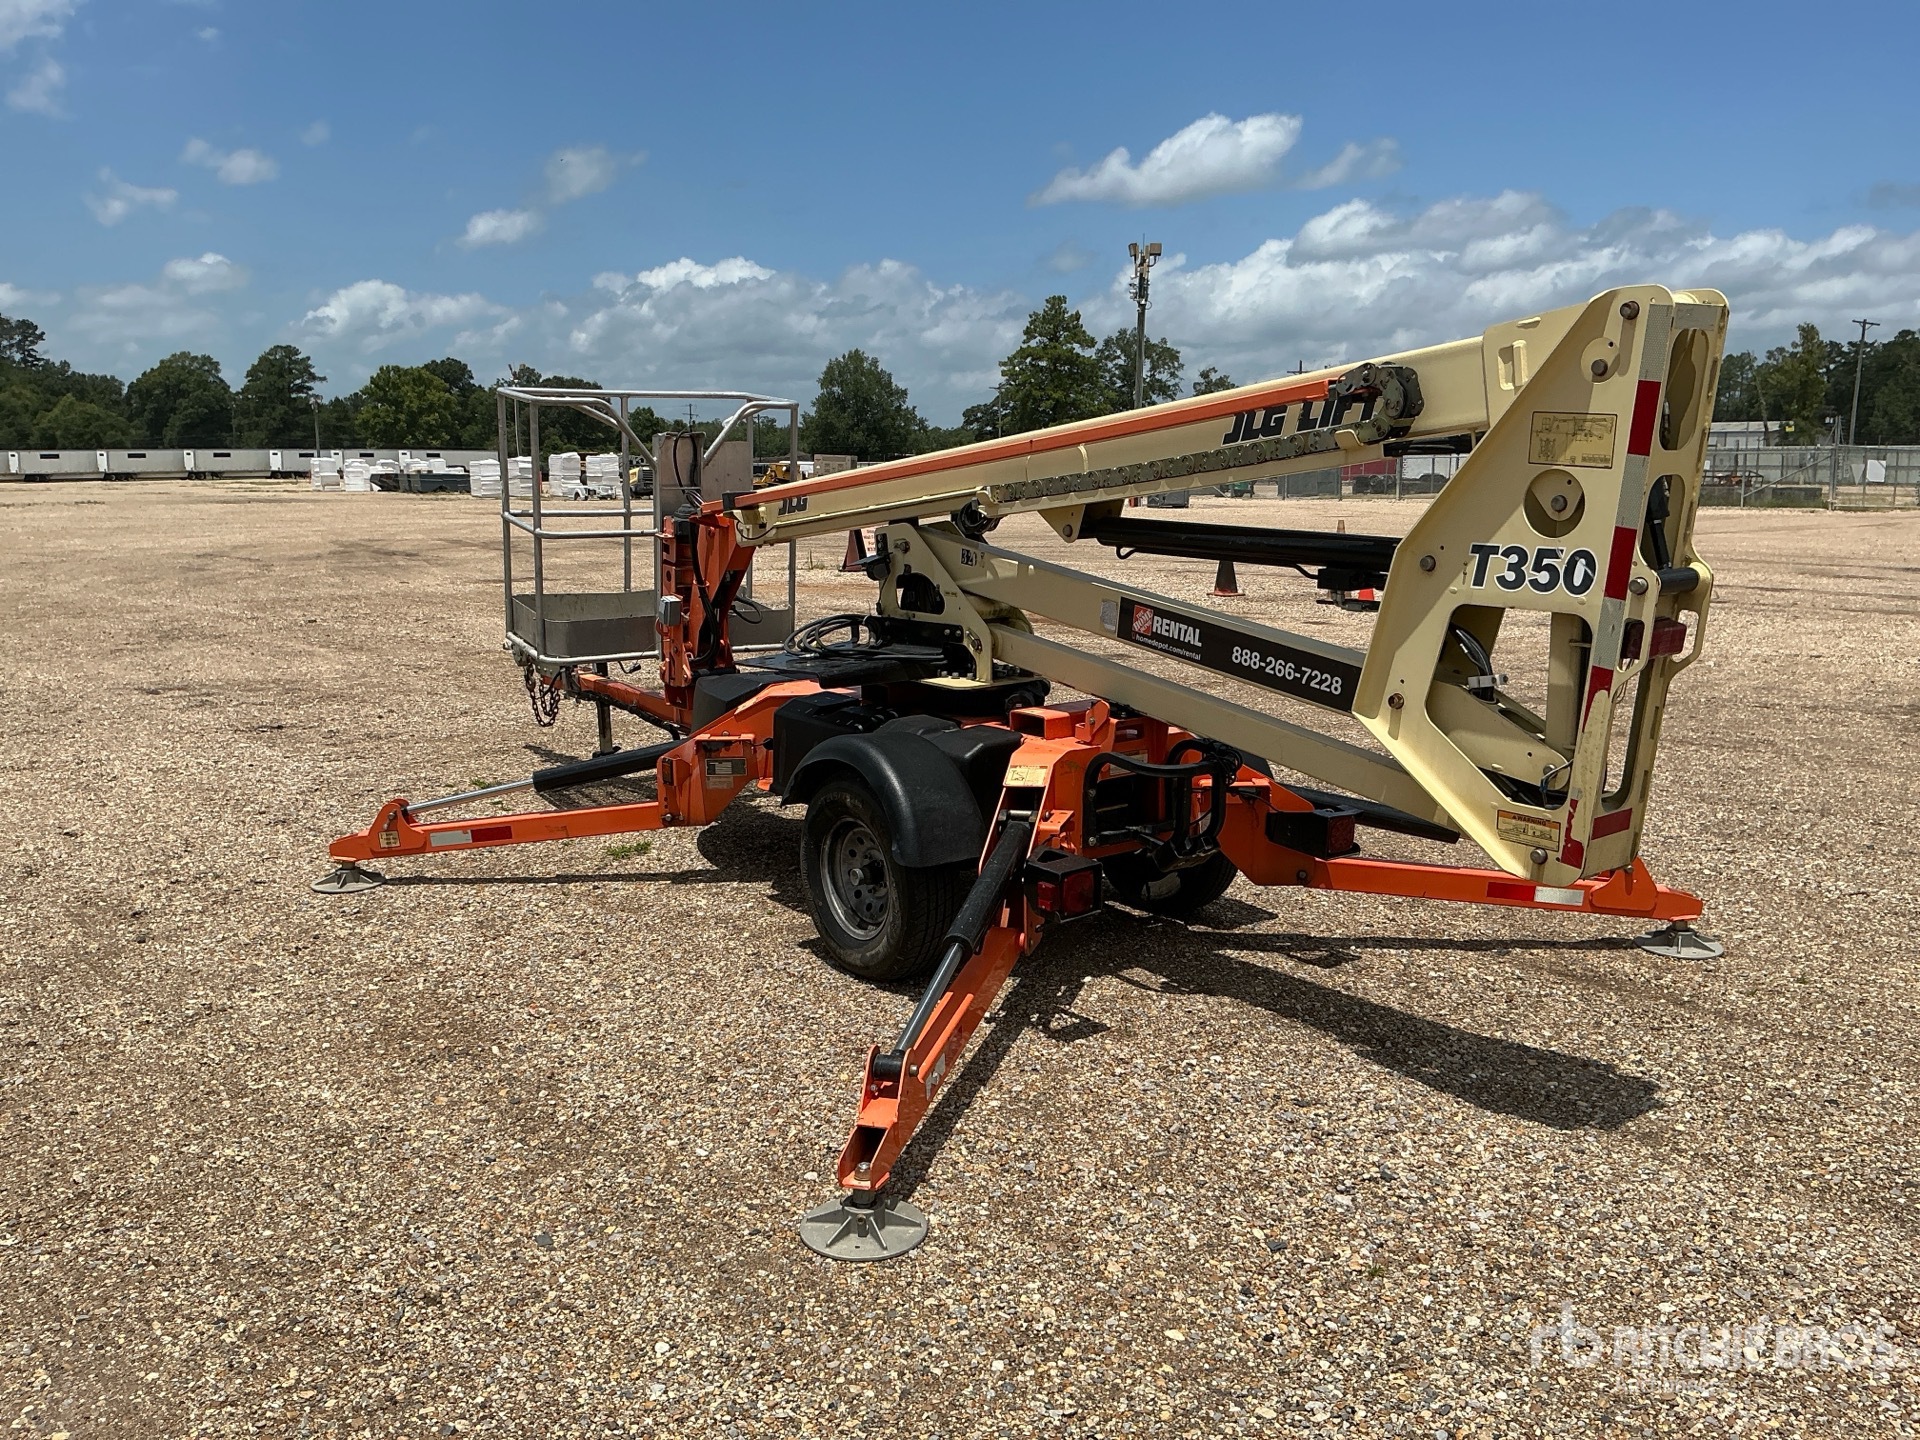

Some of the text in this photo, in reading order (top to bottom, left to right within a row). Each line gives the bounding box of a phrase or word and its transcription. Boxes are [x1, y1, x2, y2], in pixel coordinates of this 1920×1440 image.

[1222, 405, 1288, 445] JLG
[778, 494, 808, 516] JLG
[1469, 542, 1598, 597] T350
[1135, 633, 1202, 661] homedepot.com/rental
[1152, 615, 1202, 648] RENTAL
[1231, 646, 1343, 696] 888-266-7228
[1517, 814, 1548, 827] WARNING
